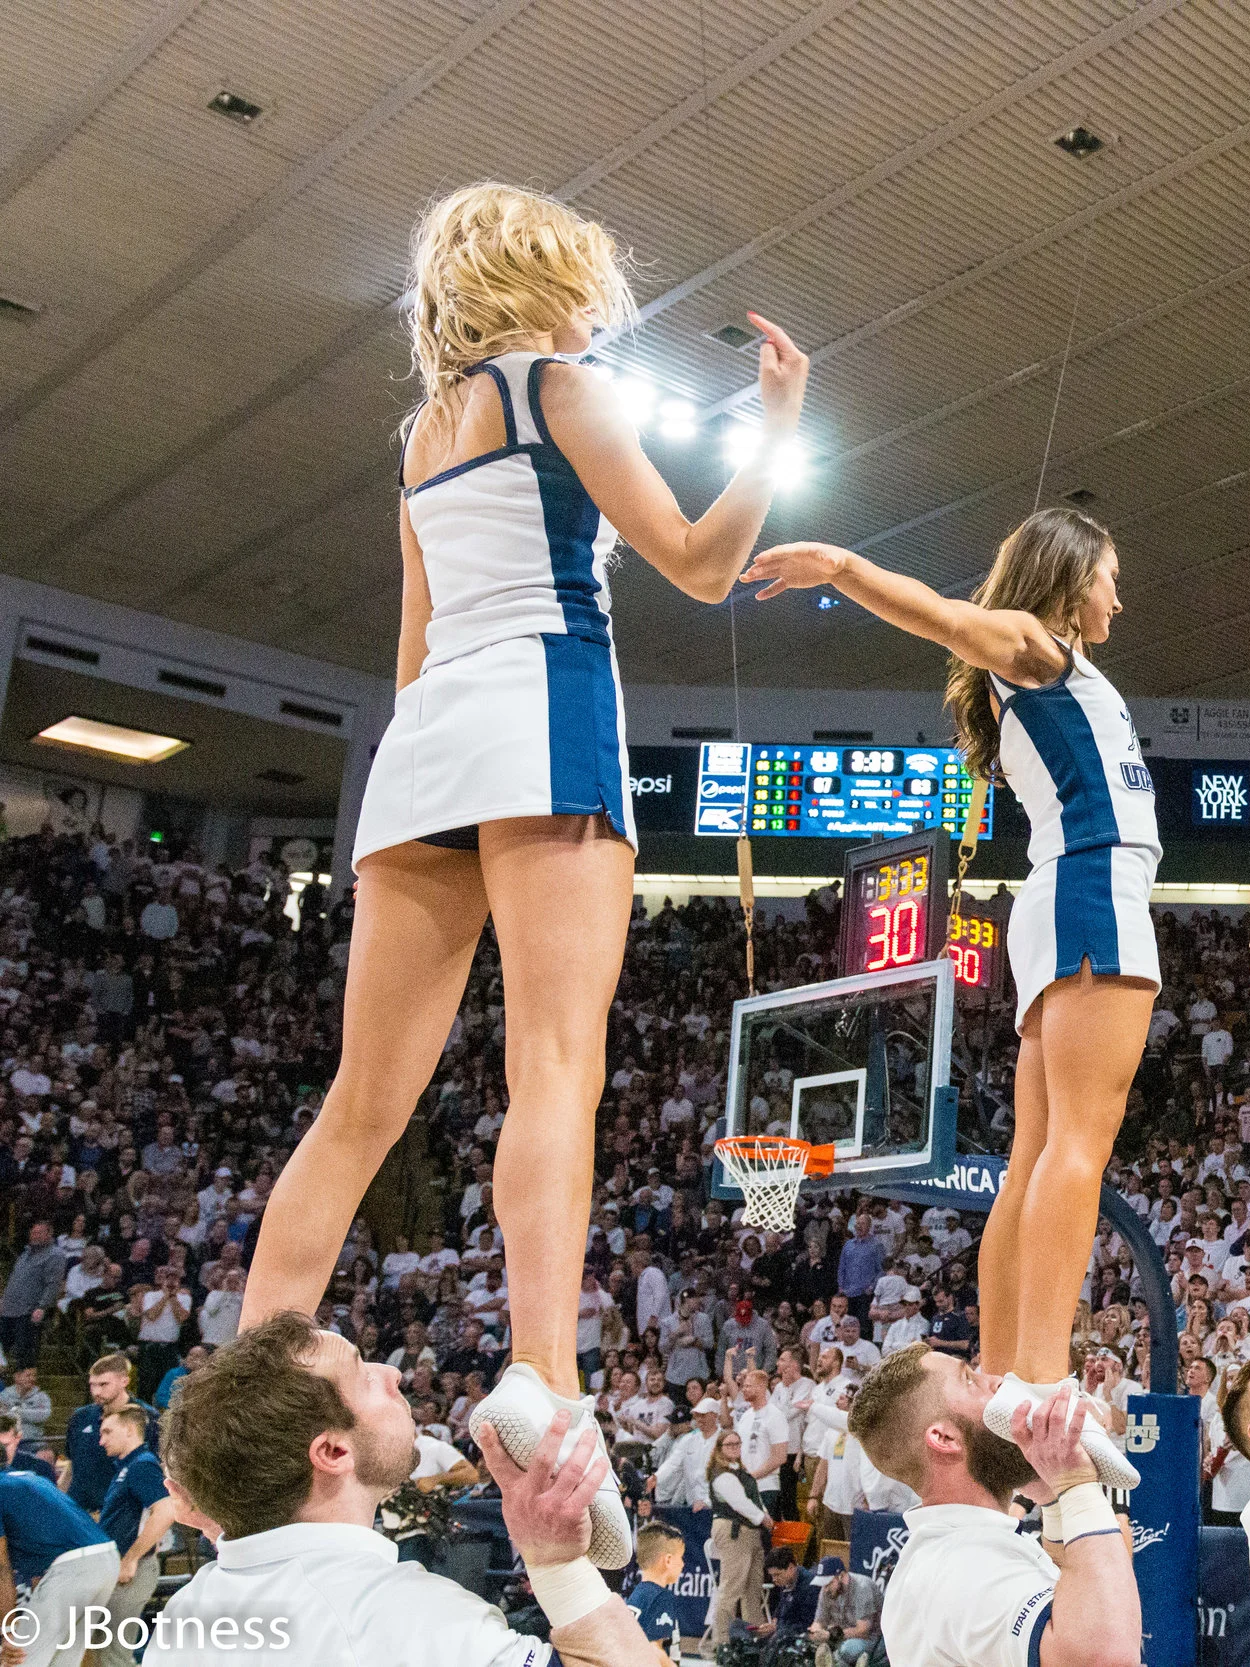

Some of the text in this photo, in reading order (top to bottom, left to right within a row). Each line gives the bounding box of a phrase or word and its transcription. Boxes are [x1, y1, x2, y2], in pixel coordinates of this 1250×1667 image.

[1232, 709, 1249, 719] FAN
[629, 774, 672, 797] epsi
[1120, 762, 1156, 796] UTA
[1202, 775, 1243, 790] NEW
[1195, 788, 1248, 806] YORK
[1202, 804, 1242, 819] LIFE
[878, 856, 928, 901] 3:33
[867, 900, 919, 971] 30
[950, 913, 994, 948] 3:33
[910, 1164, 996, 1194] RICA
[1011, 1607, 1030, 1636] UTAH
